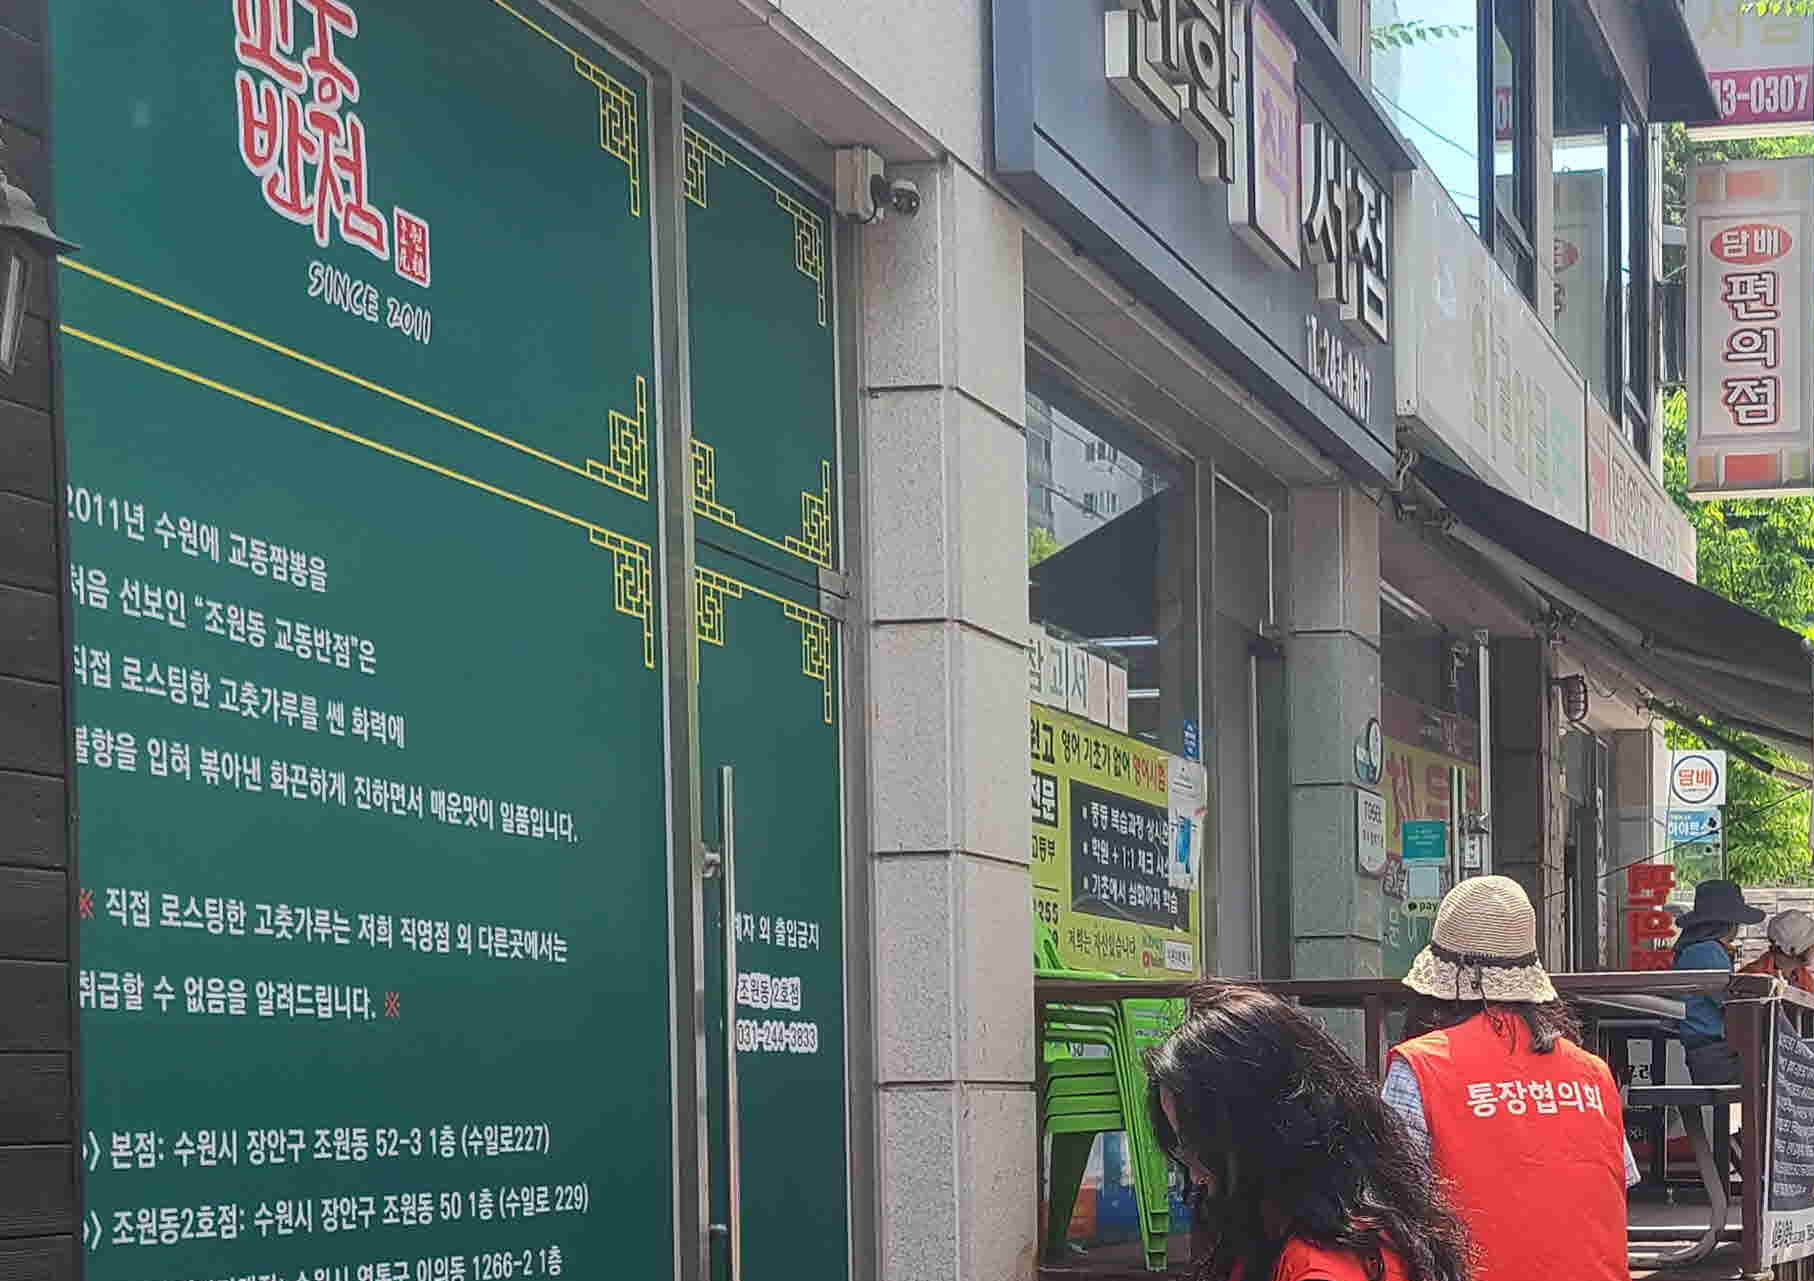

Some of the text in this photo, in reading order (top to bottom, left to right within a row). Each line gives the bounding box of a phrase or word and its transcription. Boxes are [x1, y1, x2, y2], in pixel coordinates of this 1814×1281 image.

[235, 68, 390, 262] 반점
[1722, 229, 1781, 258] 담배
[307, 260, 432, 344] SINCE 2011
[1721, 270, 1780, 427] 편의점
[154, 511, 220, 563] 수원에
[228, 532, 328, 593] 교동짬뽕을
[119, 577, 188, 630] 선보인
[72, 645, 112, 690] 직접
[120, 655, 212, 710] 로스팅한
[218, 676, 320, 733] 고춧가루를
[351, 705, 405, 749] 화력에
[75, 725, 580, 843] 불향을 입혀 볶아낸 화끈하게 진하면서 매운맛이 일품입니다.
[1679, 768, 1713, 788] 담배
[105, 887, 568, 963] 직접 로스팅한 고춧가루는 저희 직영점 외 다른곳에서는
[759, 913, 771, 945] 외
[775, 916, 820, 952] 출입금지
[79, 970, 377, 1020] 취급할 수 없음을 알려드립니다.
[736, 972, 801, 1011] 조원동 2호점
[1466, 1079, 1605, 1118] 통장협의회
[110, 1121, 551, 1170] 본점: 수원시 장안구 조원동 52-3 1층 (수일로227)
[111, 1181, 590, 1246] 조원동2호점: 수원시 장안구 조원동 50 1층 (수일로 229)
[472, 1248, 534, 1281] 1266-2
[539, 1244, 563, 1278] 1층
